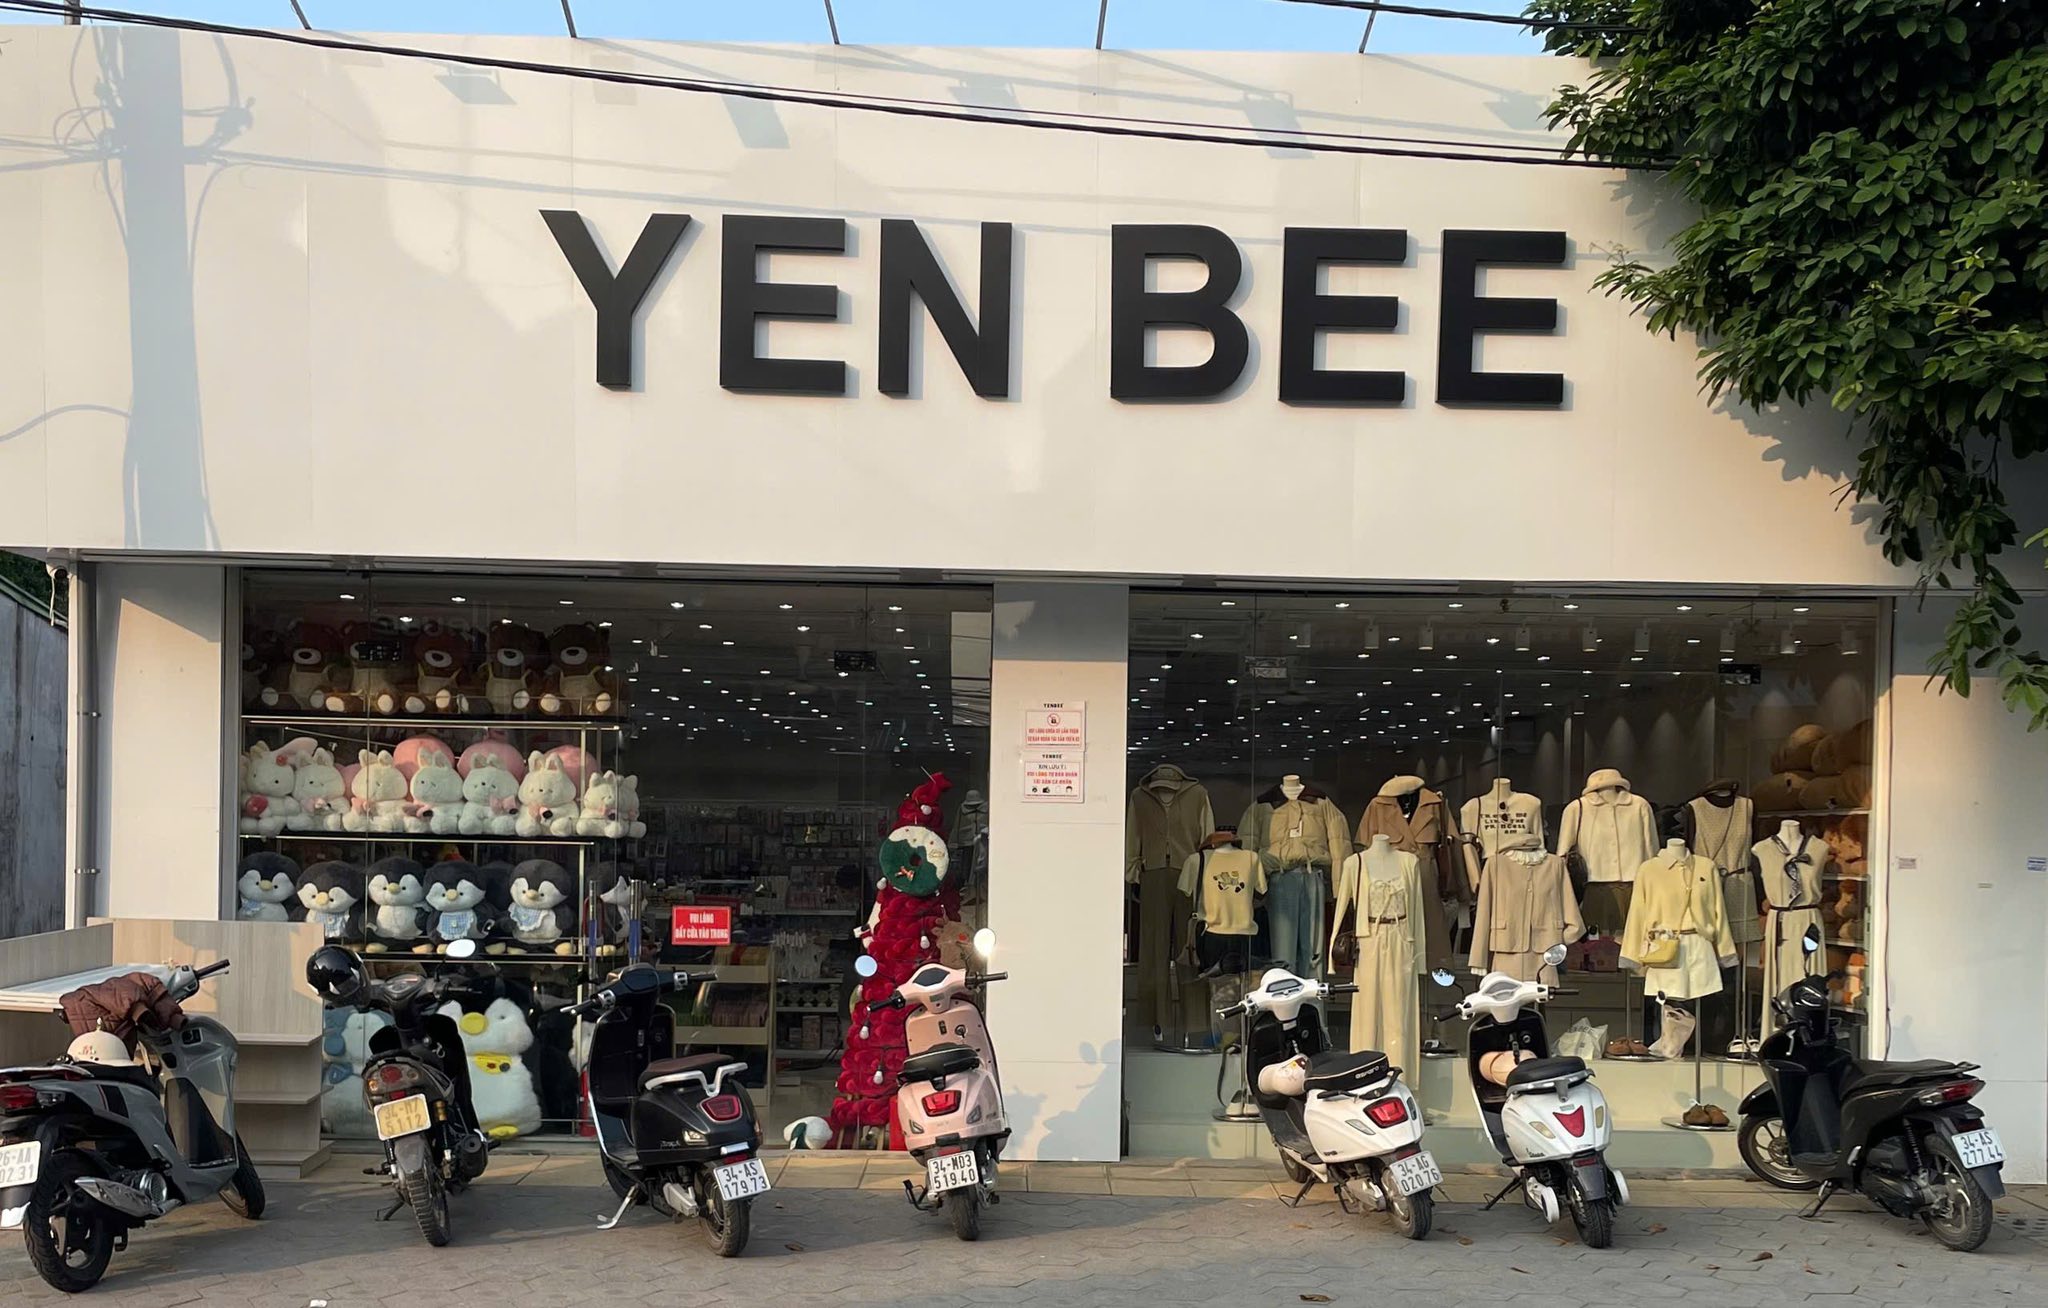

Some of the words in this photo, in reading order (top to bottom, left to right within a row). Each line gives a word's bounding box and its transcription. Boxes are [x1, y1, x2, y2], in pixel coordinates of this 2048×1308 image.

[540, 209, 1014, 399] YEN
[1110, 223, 1567, 408] BEE
[1961, 1131, 1993, 1149] 34-AS
[723, 1162, 758, 1182] 34-AS
[1397, 1155, 1429, 1177] 34-AG
[724, 1176, 767, 1198] 179.73
